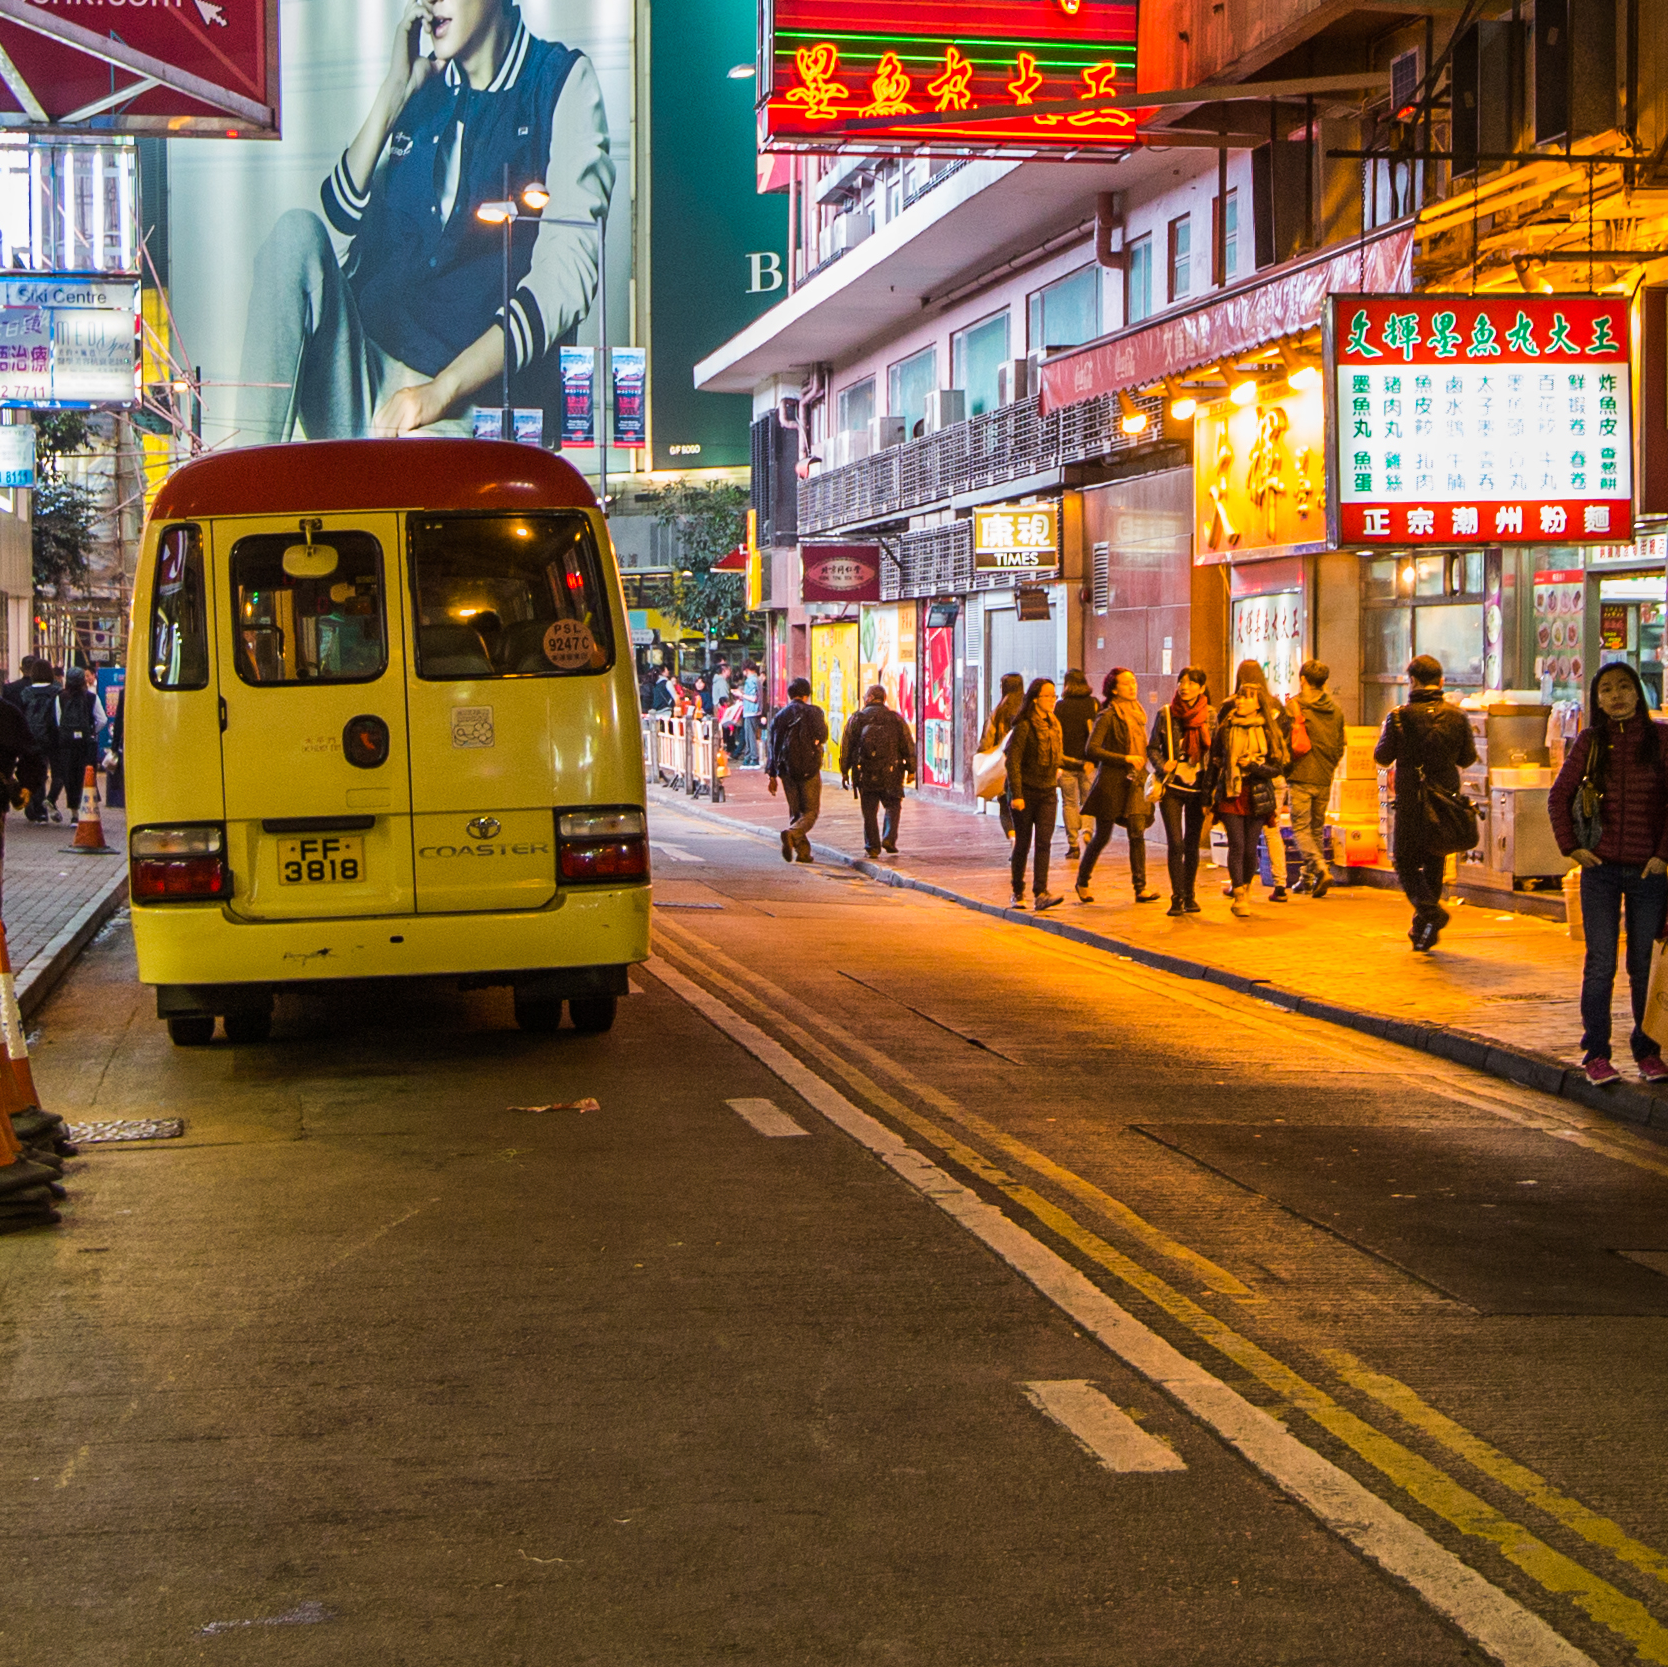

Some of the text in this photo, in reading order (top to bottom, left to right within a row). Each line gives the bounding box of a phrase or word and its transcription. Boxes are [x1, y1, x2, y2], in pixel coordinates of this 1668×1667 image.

[53, 289, 107, 304] Centre
[1346, 309, 1620, 361] 文輝墨魚丸大王
[14, 385, 46, 399] 7711
[1352, 374, 1372, 439] 墨魚丸
[1383, 374, 1403, 439] 豬肉丸
[1598, 374, 1618, 439] 炸魚皮
[1353, 451, 1373, 493] 魚蛋
[980, 513, 1051, 548] 康視
[1362, 504, 1611, 536] 正宗潮州粉麵
[993, 551, 1040, 567] TIMES
[553, 623, 582, 635] PSL
[301, 839, 340, 861] FF
[418, 844, 549, 859] COASTER
[284, 859, 359, 882] 3818
